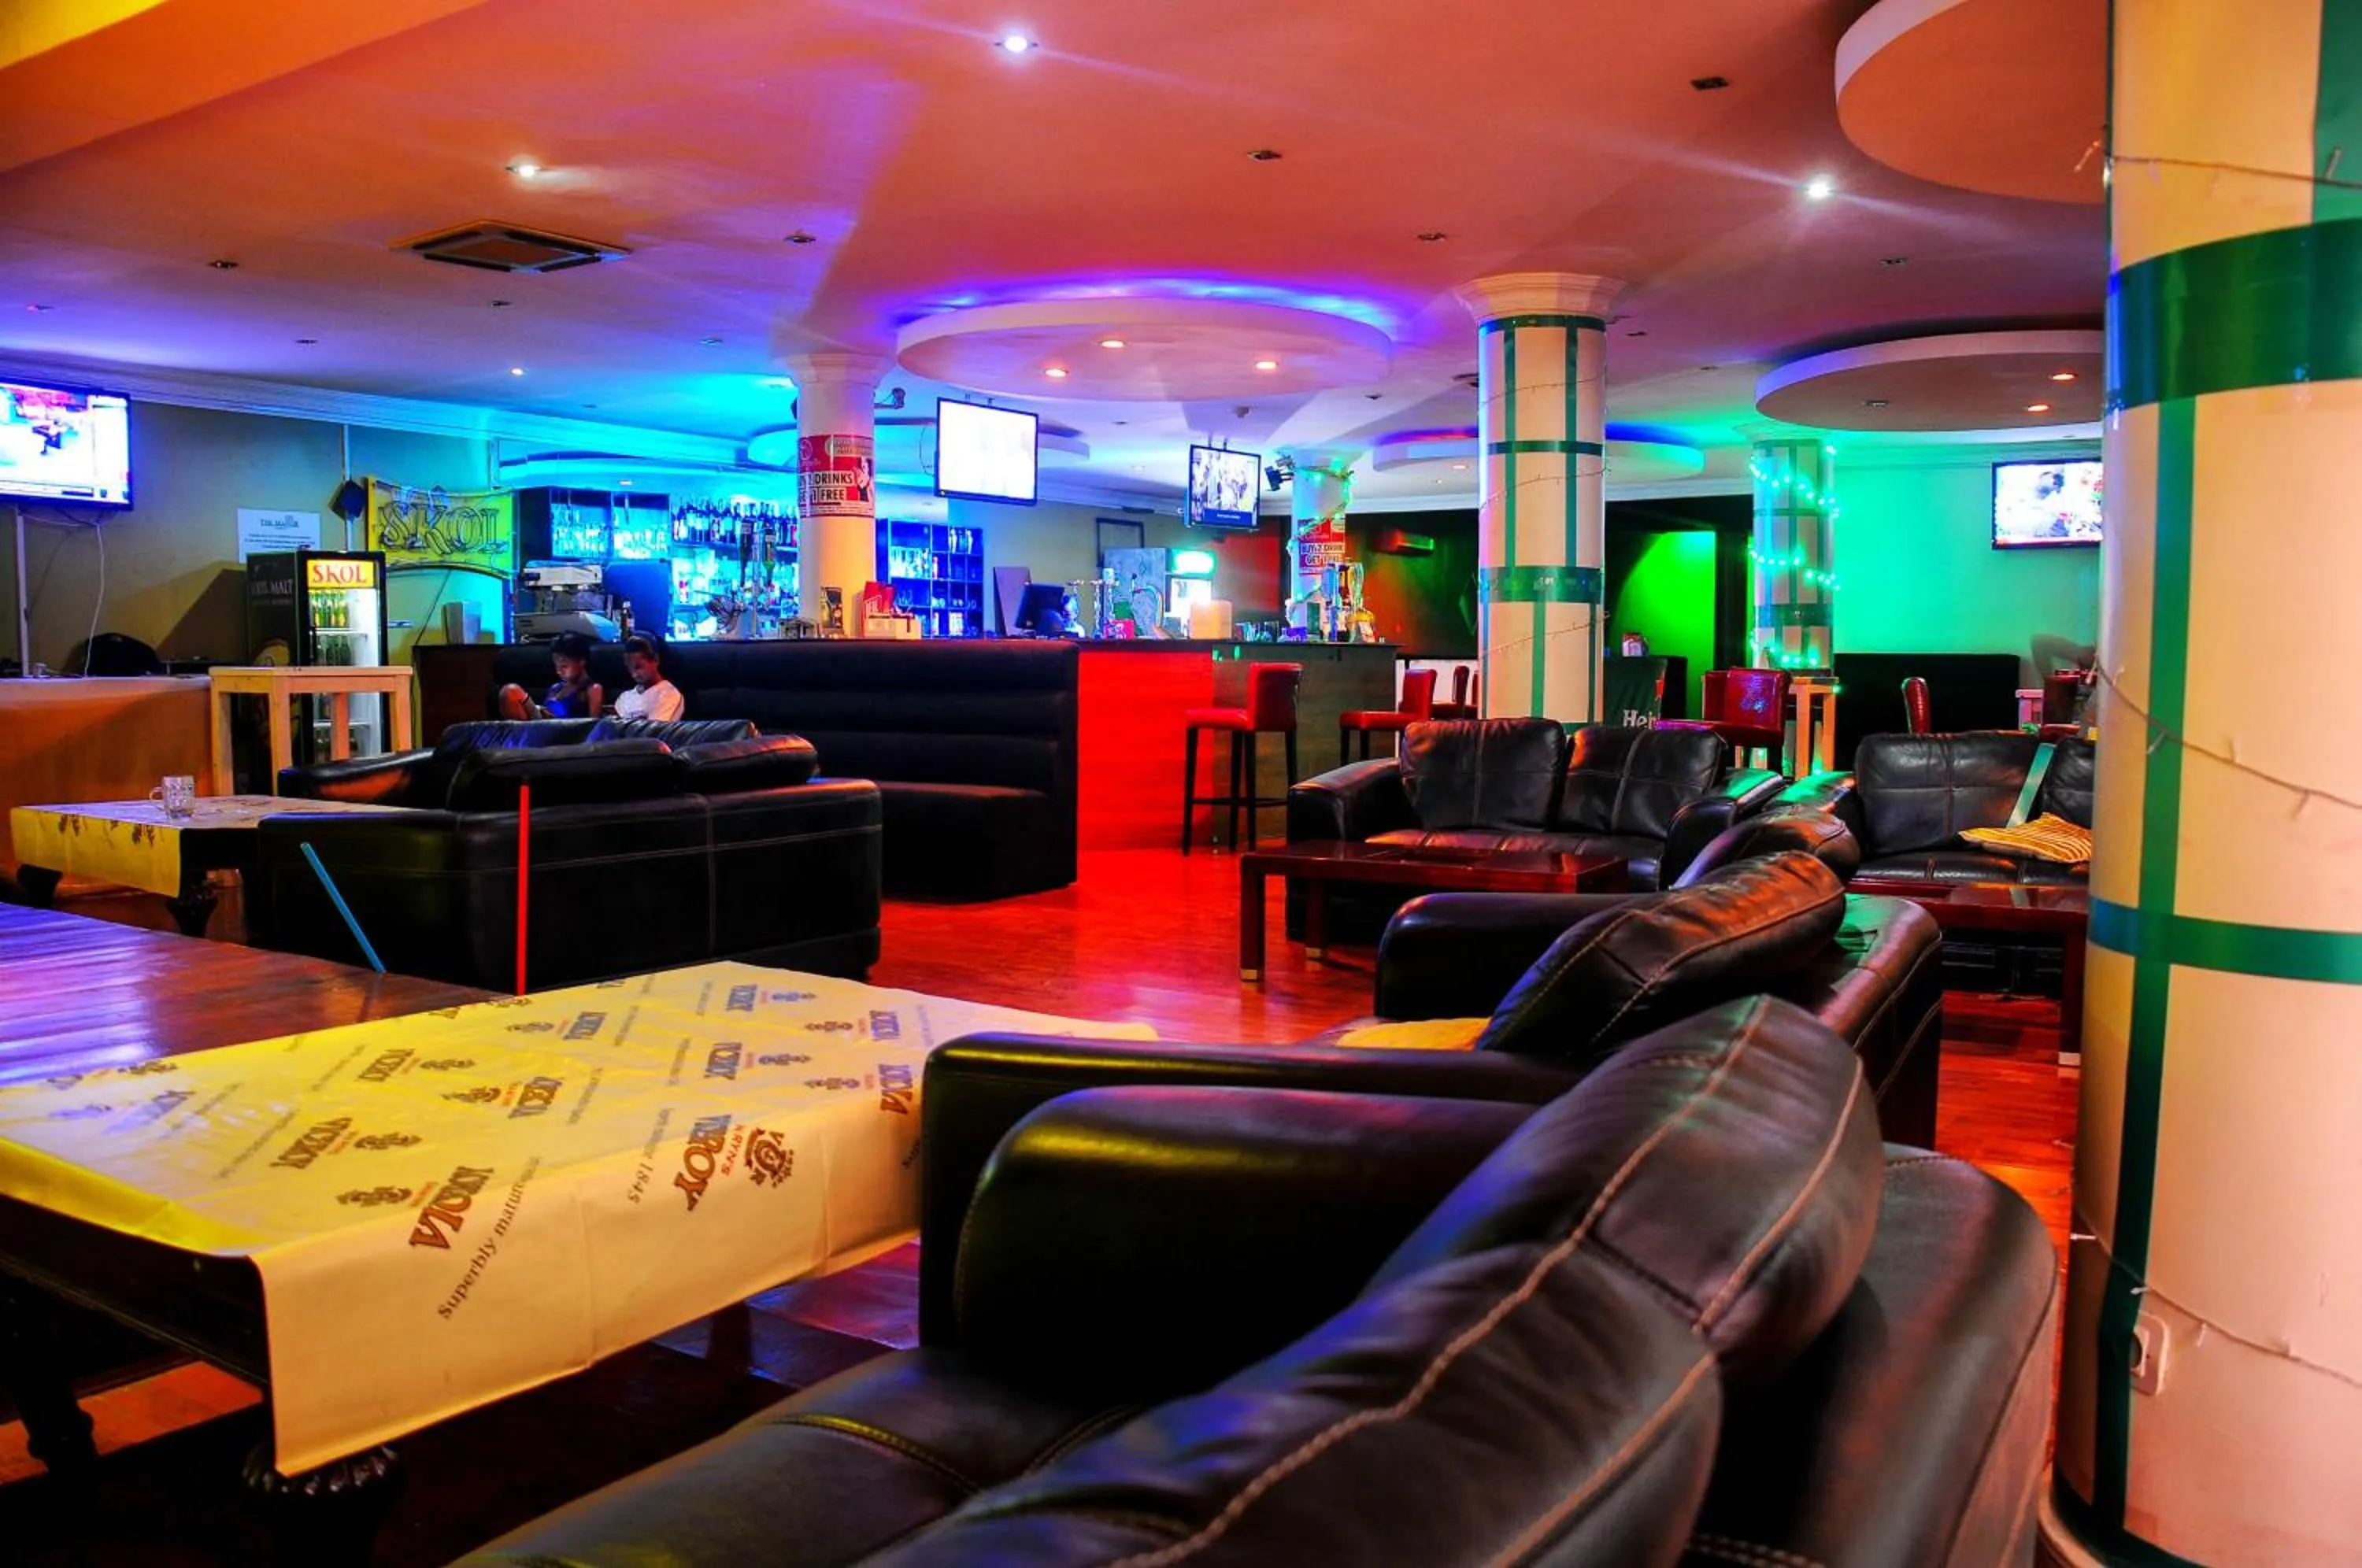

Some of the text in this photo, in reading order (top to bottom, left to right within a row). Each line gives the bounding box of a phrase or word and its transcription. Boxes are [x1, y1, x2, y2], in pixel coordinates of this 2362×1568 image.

[814, 473, 853, 485] DRINKS
[820, 489, 845, 501] FREE
[378, 500, 509, 555] SKOL
[312, 564, 368, 583] SKOL
[628, 1163, 654, 1204] 1845
[438, 1237, 498, 1319] Superbly
